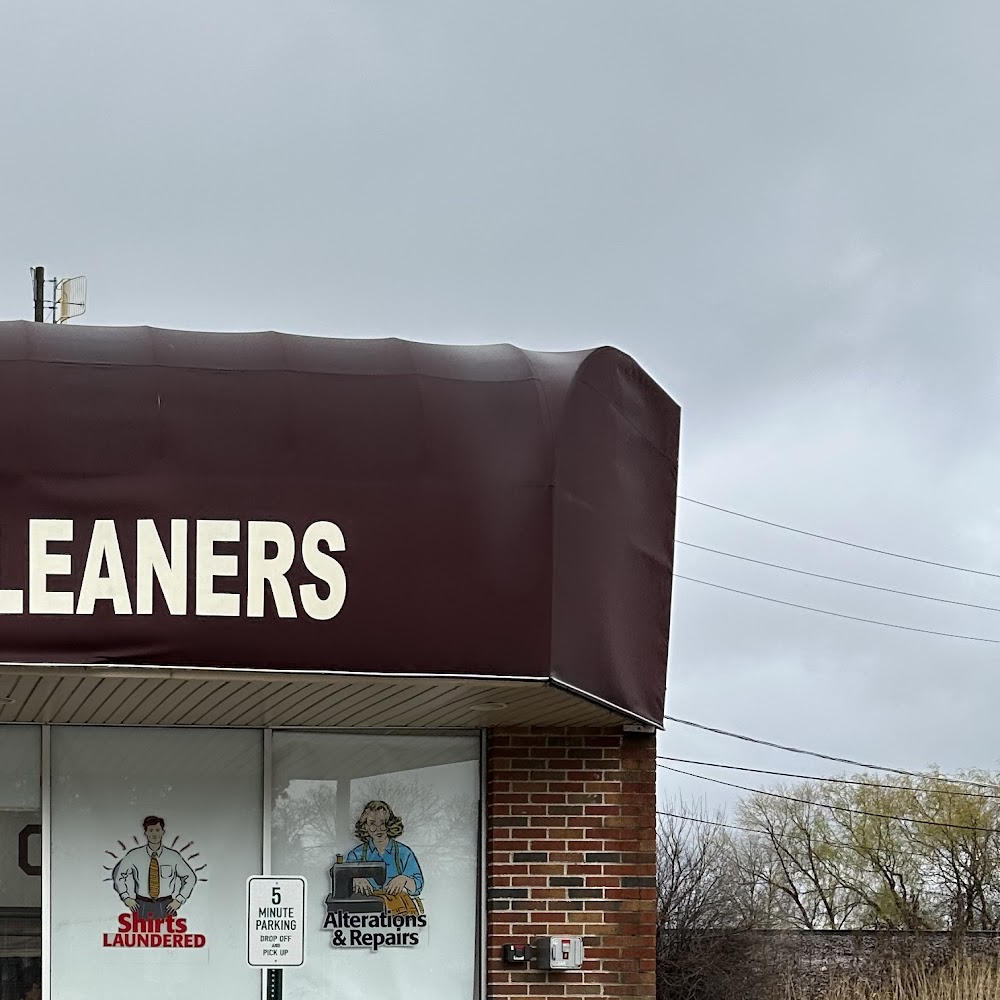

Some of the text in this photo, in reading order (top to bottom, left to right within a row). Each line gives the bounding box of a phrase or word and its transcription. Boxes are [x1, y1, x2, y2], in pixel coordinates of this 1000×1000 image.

[271, 886, 282, 905] 5
[258, 907, 294, 918] MINUTE
[323, 909, 427, 929] Alterations
[117, 911, 188, 934] Shirts
[255, 919, 297, 931] PARKING
[102, 933, 206, 948] LAUNDERED
[279, 935, 292, 943] OFF
[332, 927, 419, 951] & Repairs
